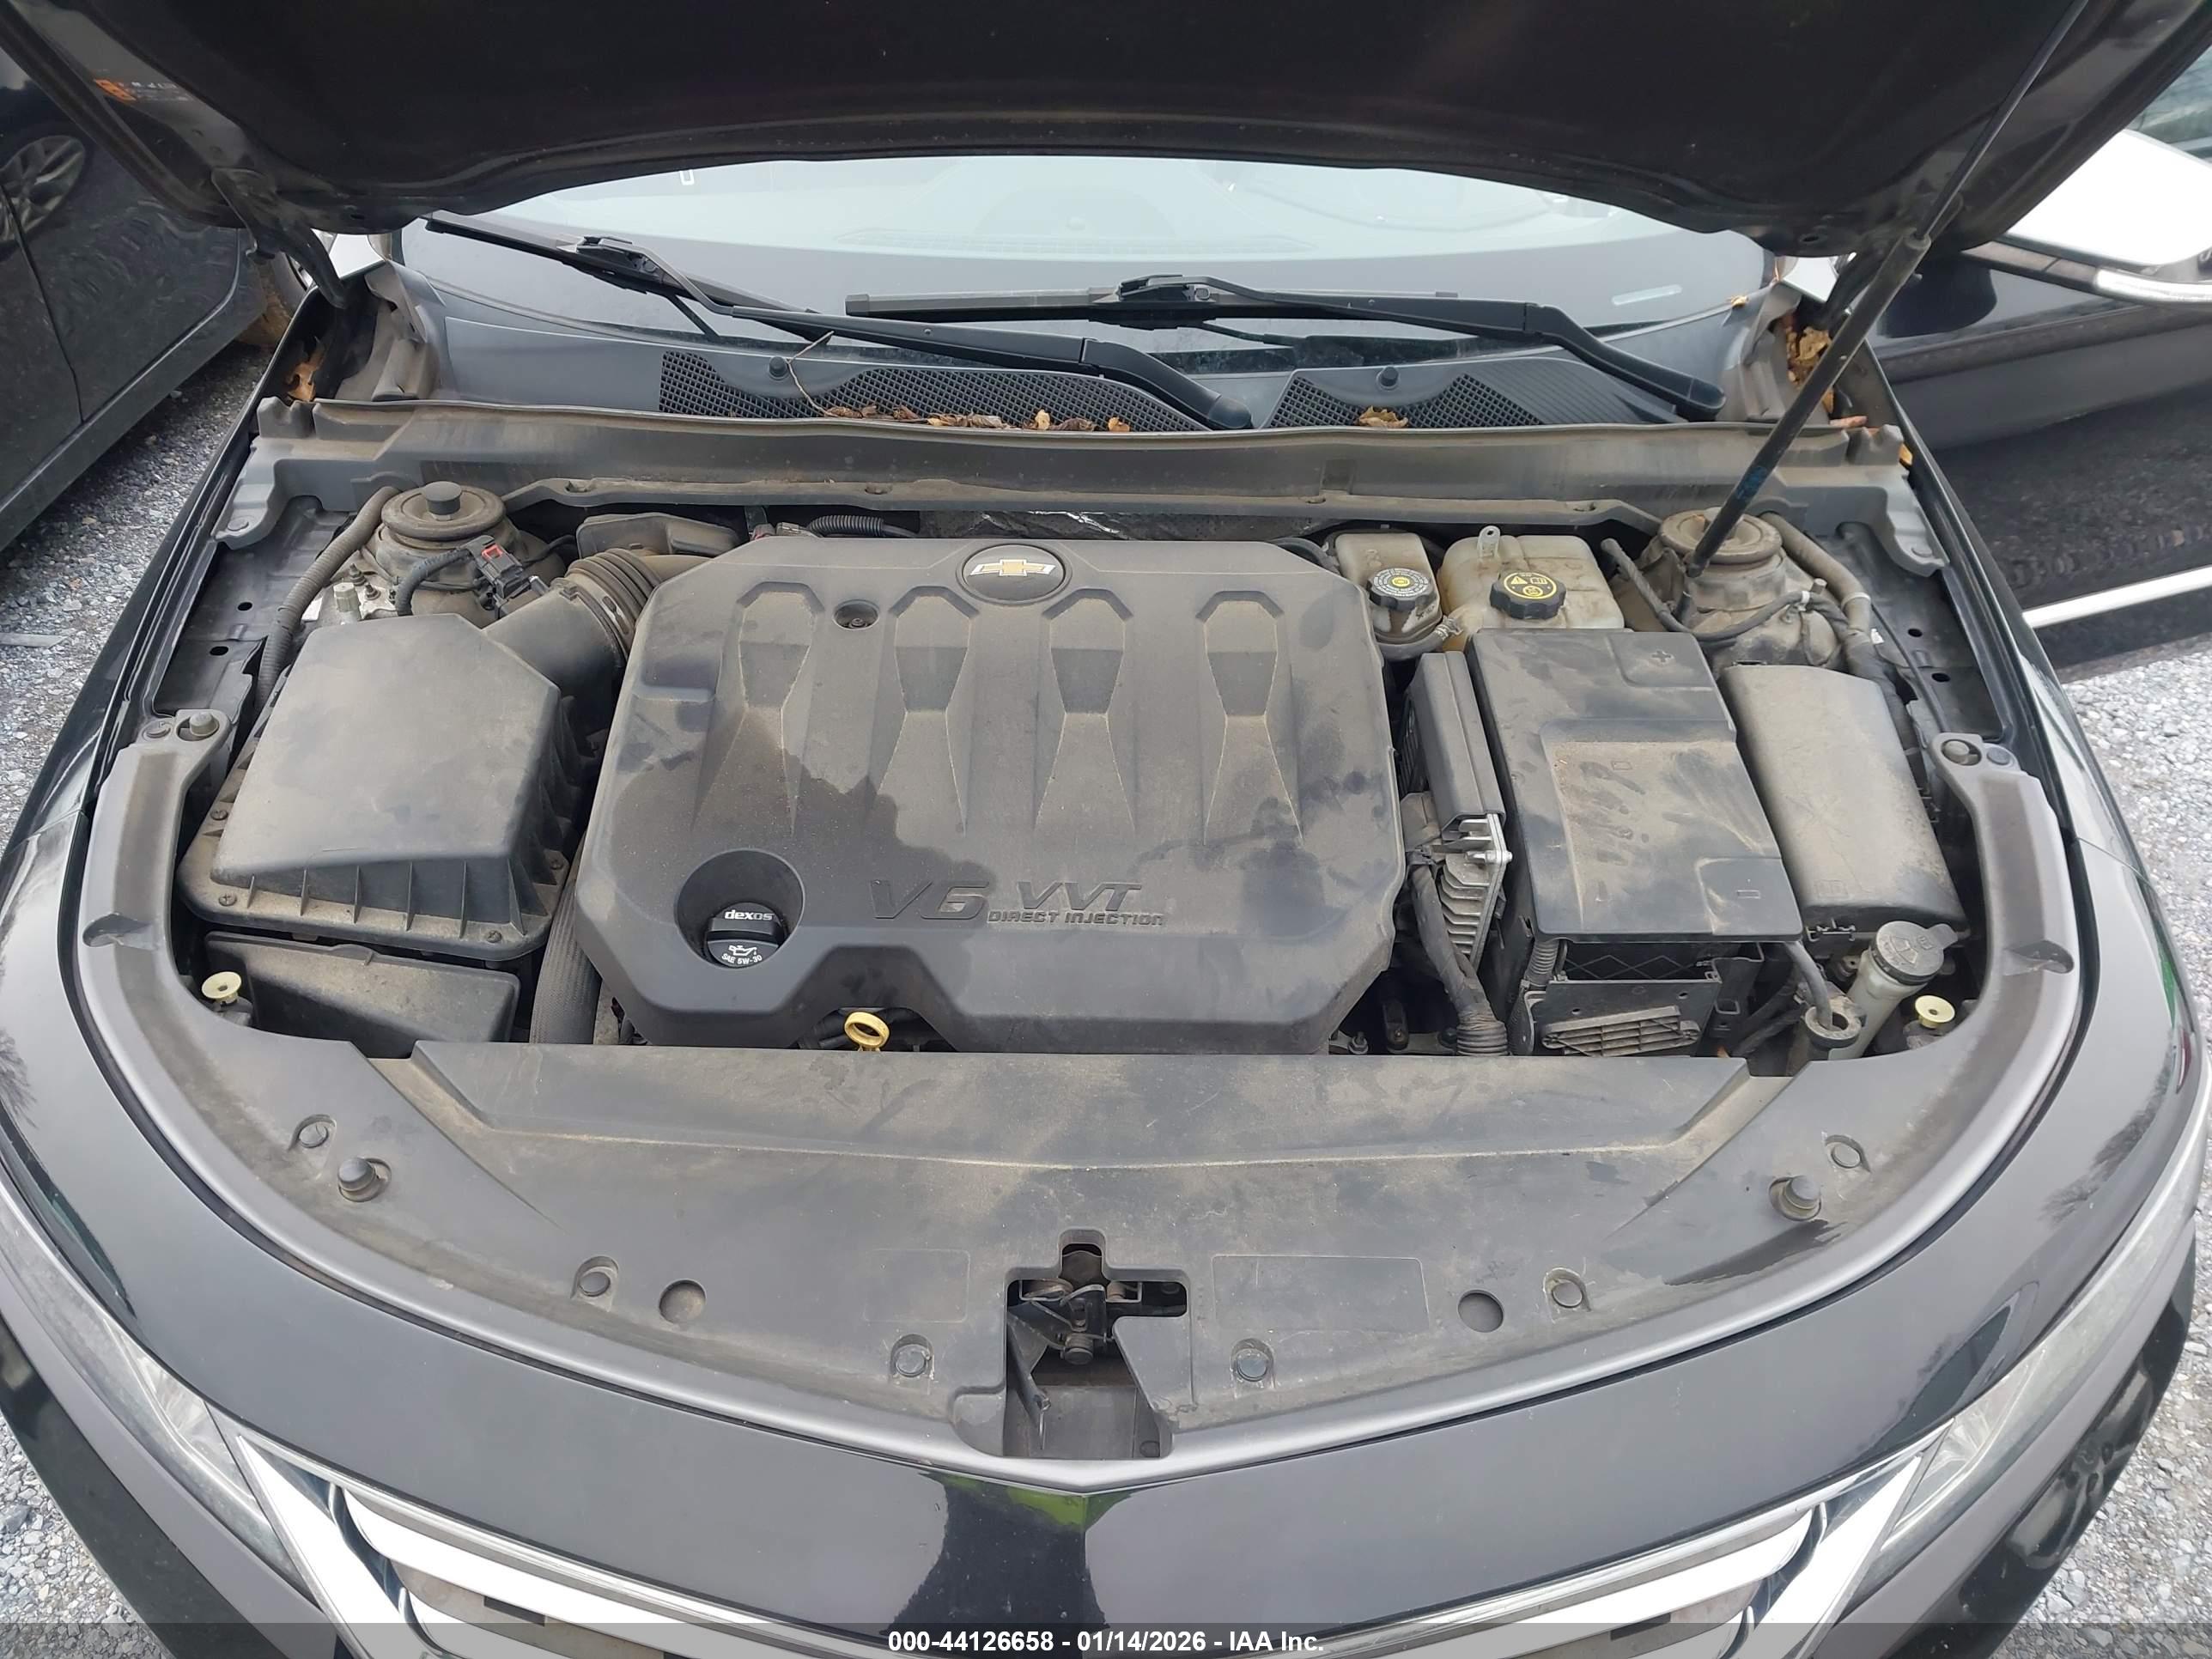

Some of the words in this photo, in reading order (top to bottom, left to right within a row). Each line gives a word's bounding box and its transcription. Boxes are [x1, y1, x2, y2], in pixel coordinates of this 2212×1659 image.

[869, 880, 988, 920] V6
[1015, 881, 1142, 912] VVT
[725, 910, 774, 921] dexos
[988, 910, 1058, 924] DIRECT
[1064, 911, 1165, 926] INJECTION
[722, 953, 735, 963] SAE
[738, 955, 763, 964] 5W-30
